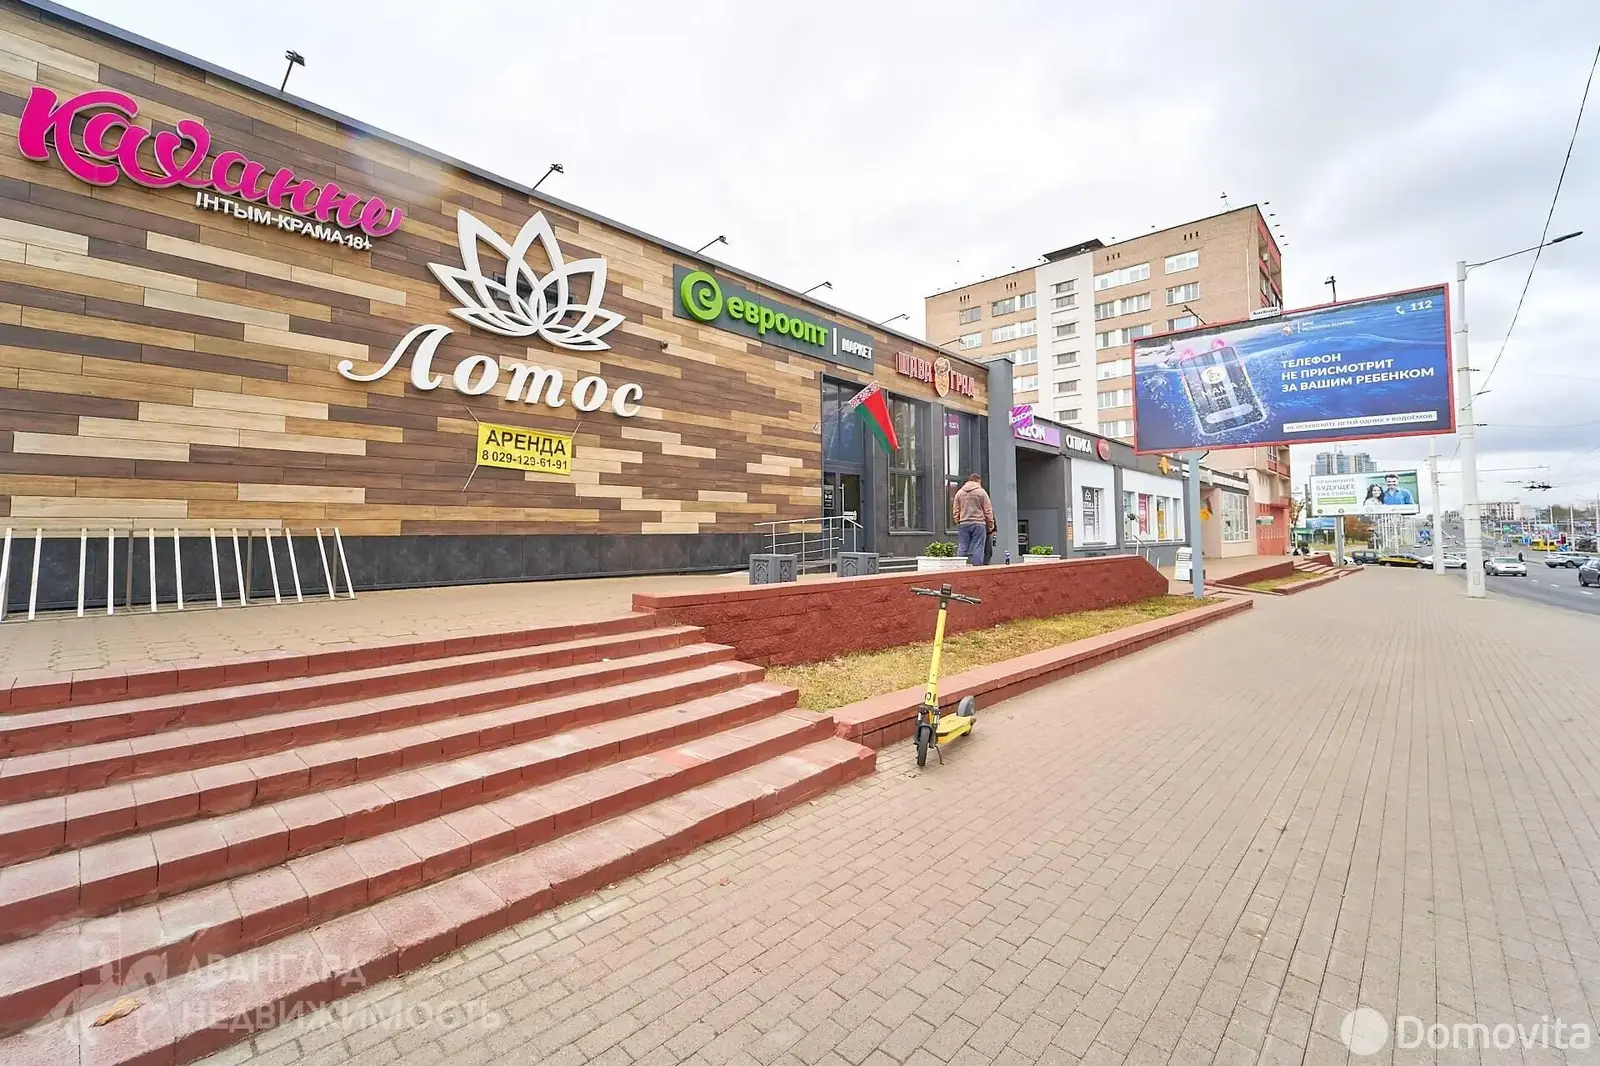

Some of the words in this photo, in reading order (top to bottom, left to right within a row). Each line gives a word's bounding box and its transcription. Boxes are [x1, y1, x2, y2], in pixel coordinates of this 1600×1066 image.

[1411, 300, 1433, 311] 112
[726, 295, 828, 346] евроопт
[841, 337, 873, 360] МАРКЕТ
[337, 323, 644, 417] Лотос
[1281, 353, 1341, 369] ТЕЛЕФОН
[1281, 371, 1297, 381] НЕ
[1301, 359, 1394, 378] ПРИСМОТРИТ
[1281, 383, 1298, 393] ЗА
[1300, 376, 1353, 391] ВАШИМ
[1356, 367, 1434, 385] РЕБЕНКОМ
[485, 429, 566, 457] АРЕНДА
[482, 449, 489, 461] 8
[492, 450, 567, 470] 029-129-61-91
[1316, 483, 1357, 491] БУДУЩЕЕ
